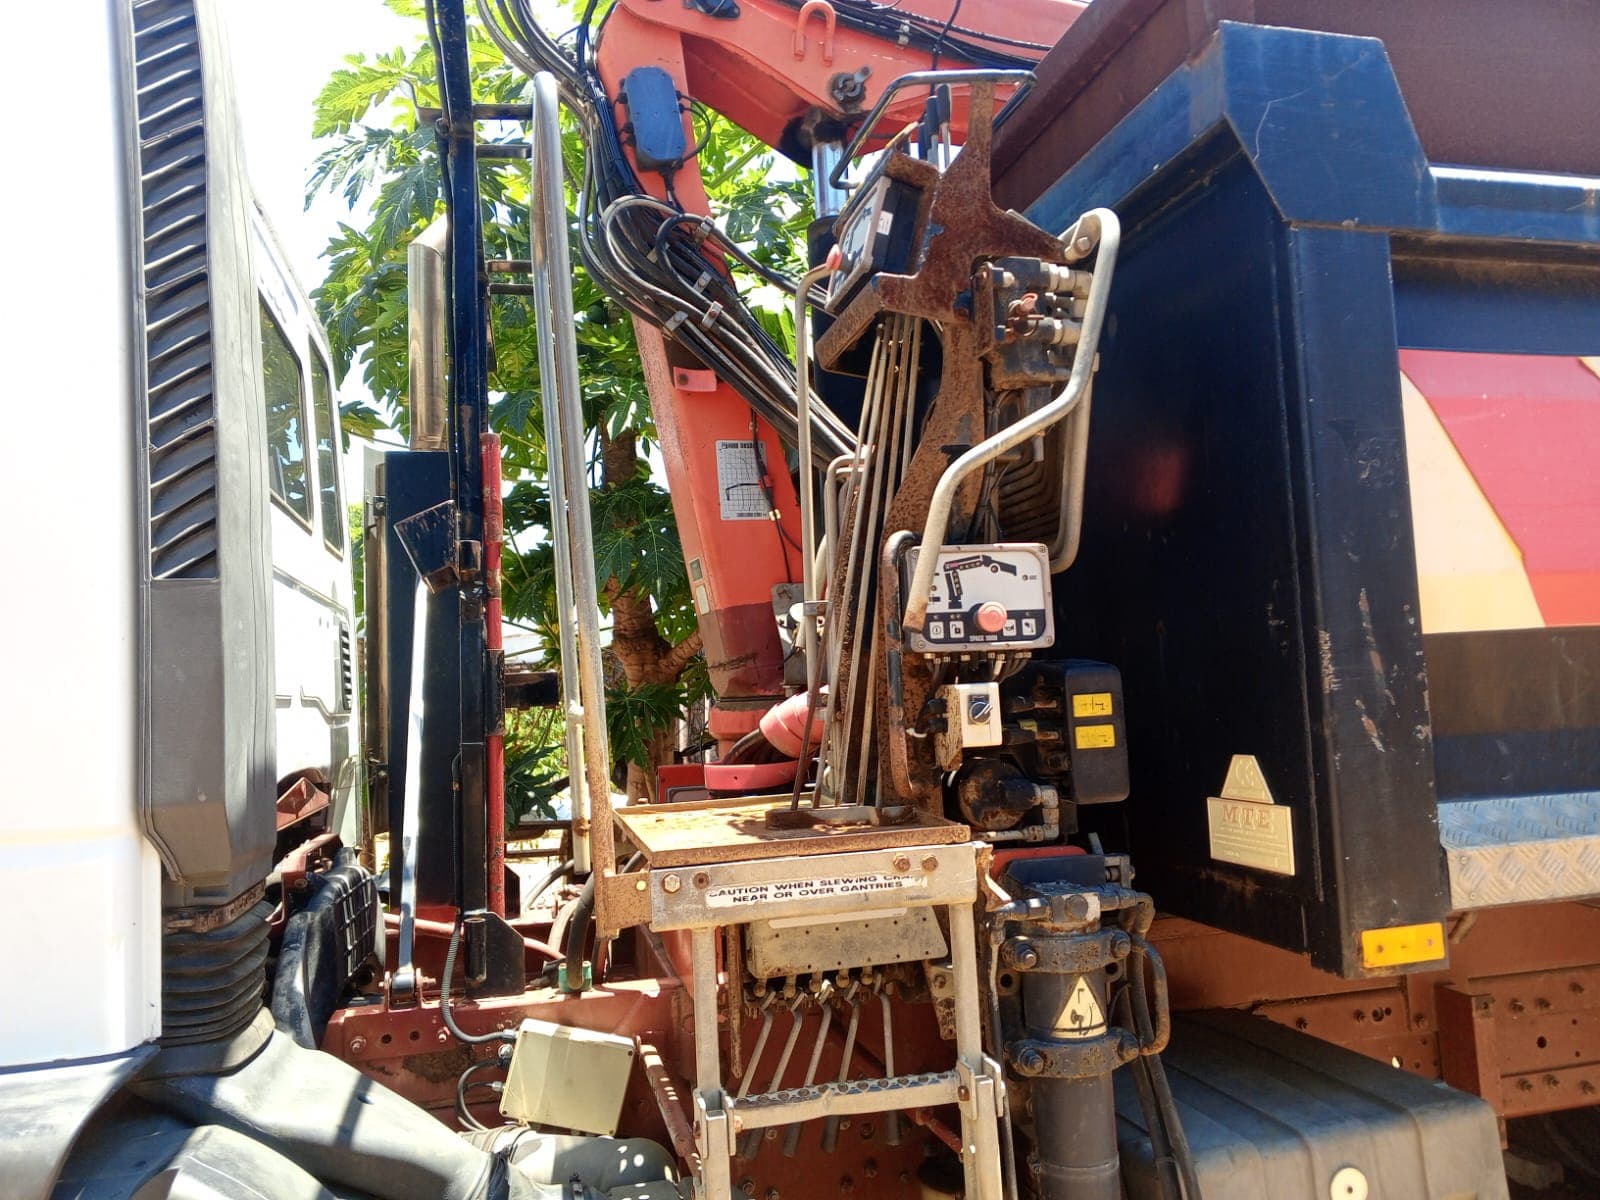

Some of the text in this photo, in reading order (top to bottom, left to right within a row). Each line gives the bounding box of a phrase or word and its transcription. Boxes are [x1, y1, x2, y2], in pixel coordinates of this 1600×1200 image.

[733, 881, 903, 903] NEAR OR OVER GANTRIES
[774, 881, 814, 891] WHEN
[820, 875, 877, 887] SLEWING
